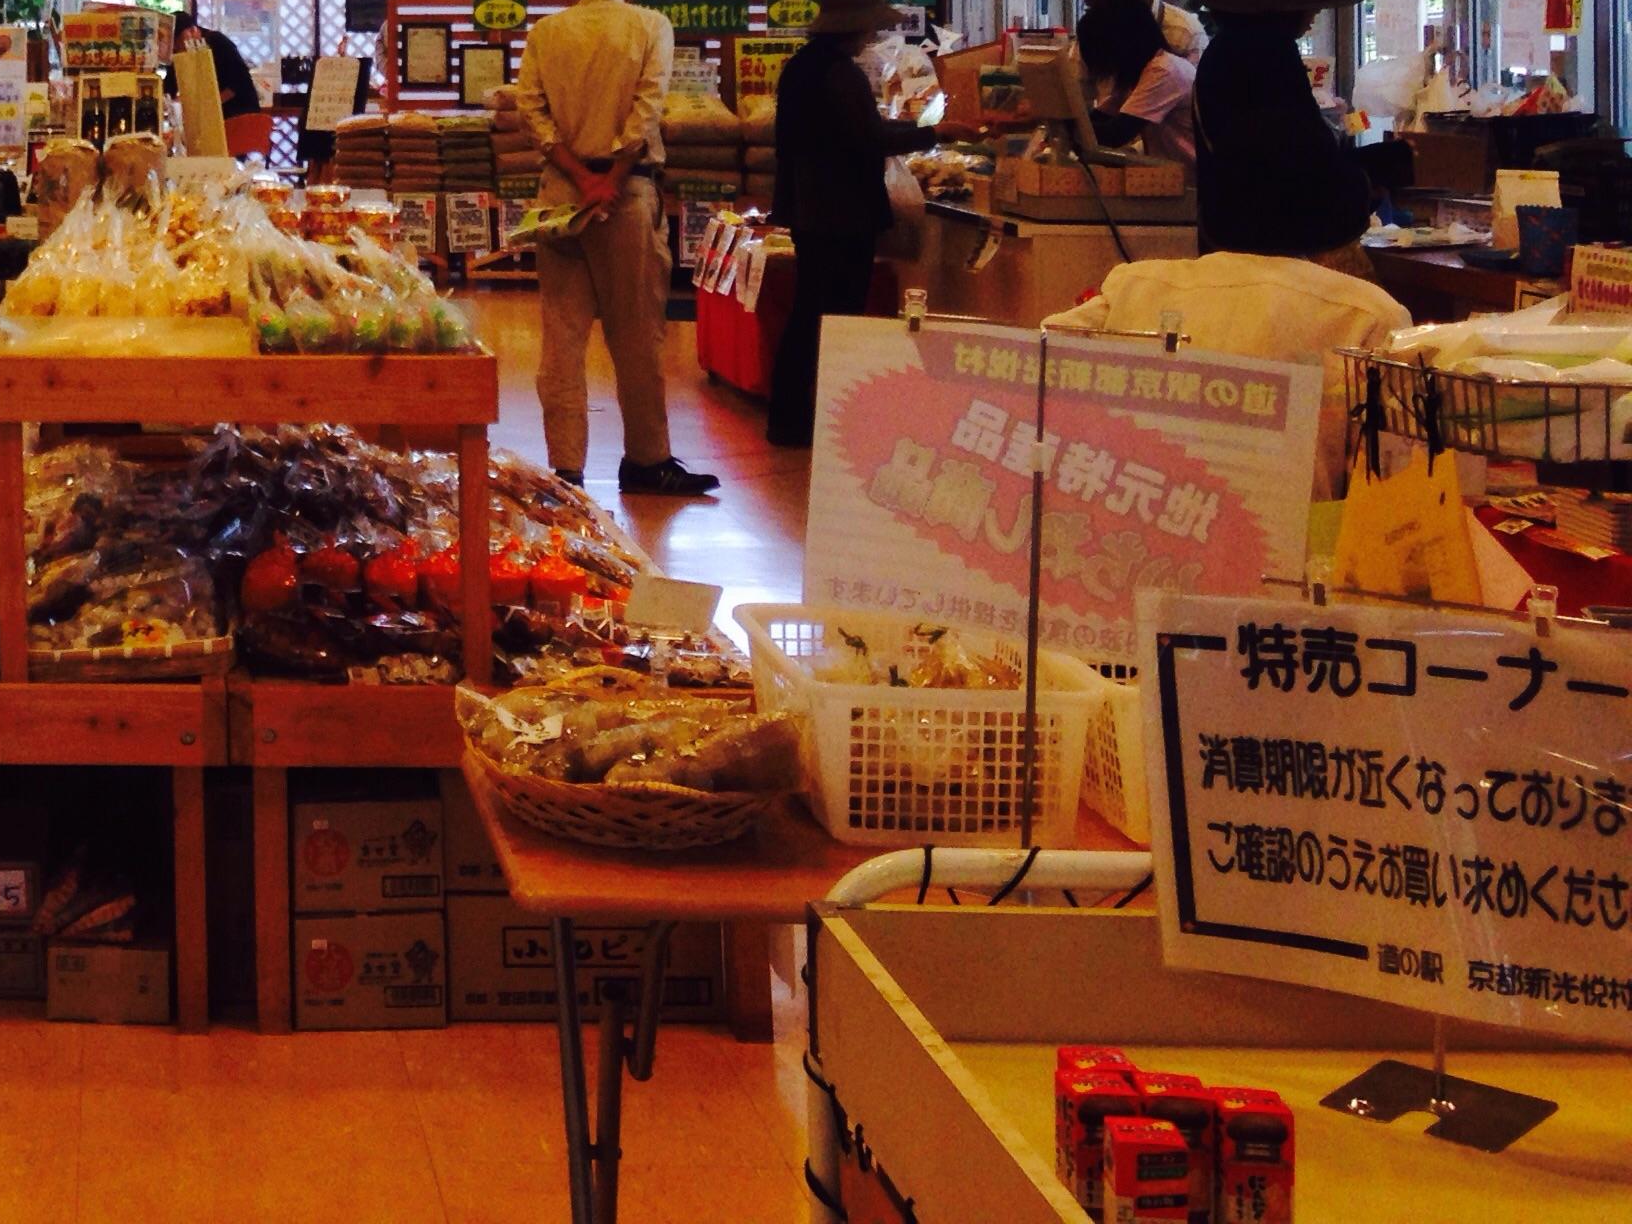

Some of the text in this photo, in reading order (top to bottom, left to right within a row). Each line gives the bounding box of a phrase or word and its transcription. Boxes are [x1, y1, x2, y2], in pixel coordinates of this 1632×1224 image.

[1236, 622, 1630, 712] 特売コーナー
[1198, 732, 1630, 838] 消費期限が近くなっておりま
[1206, 819, 1630, 931] ご確認のうえお買い求めくださ
[1377, 943, 1445, 985] 道の駅
